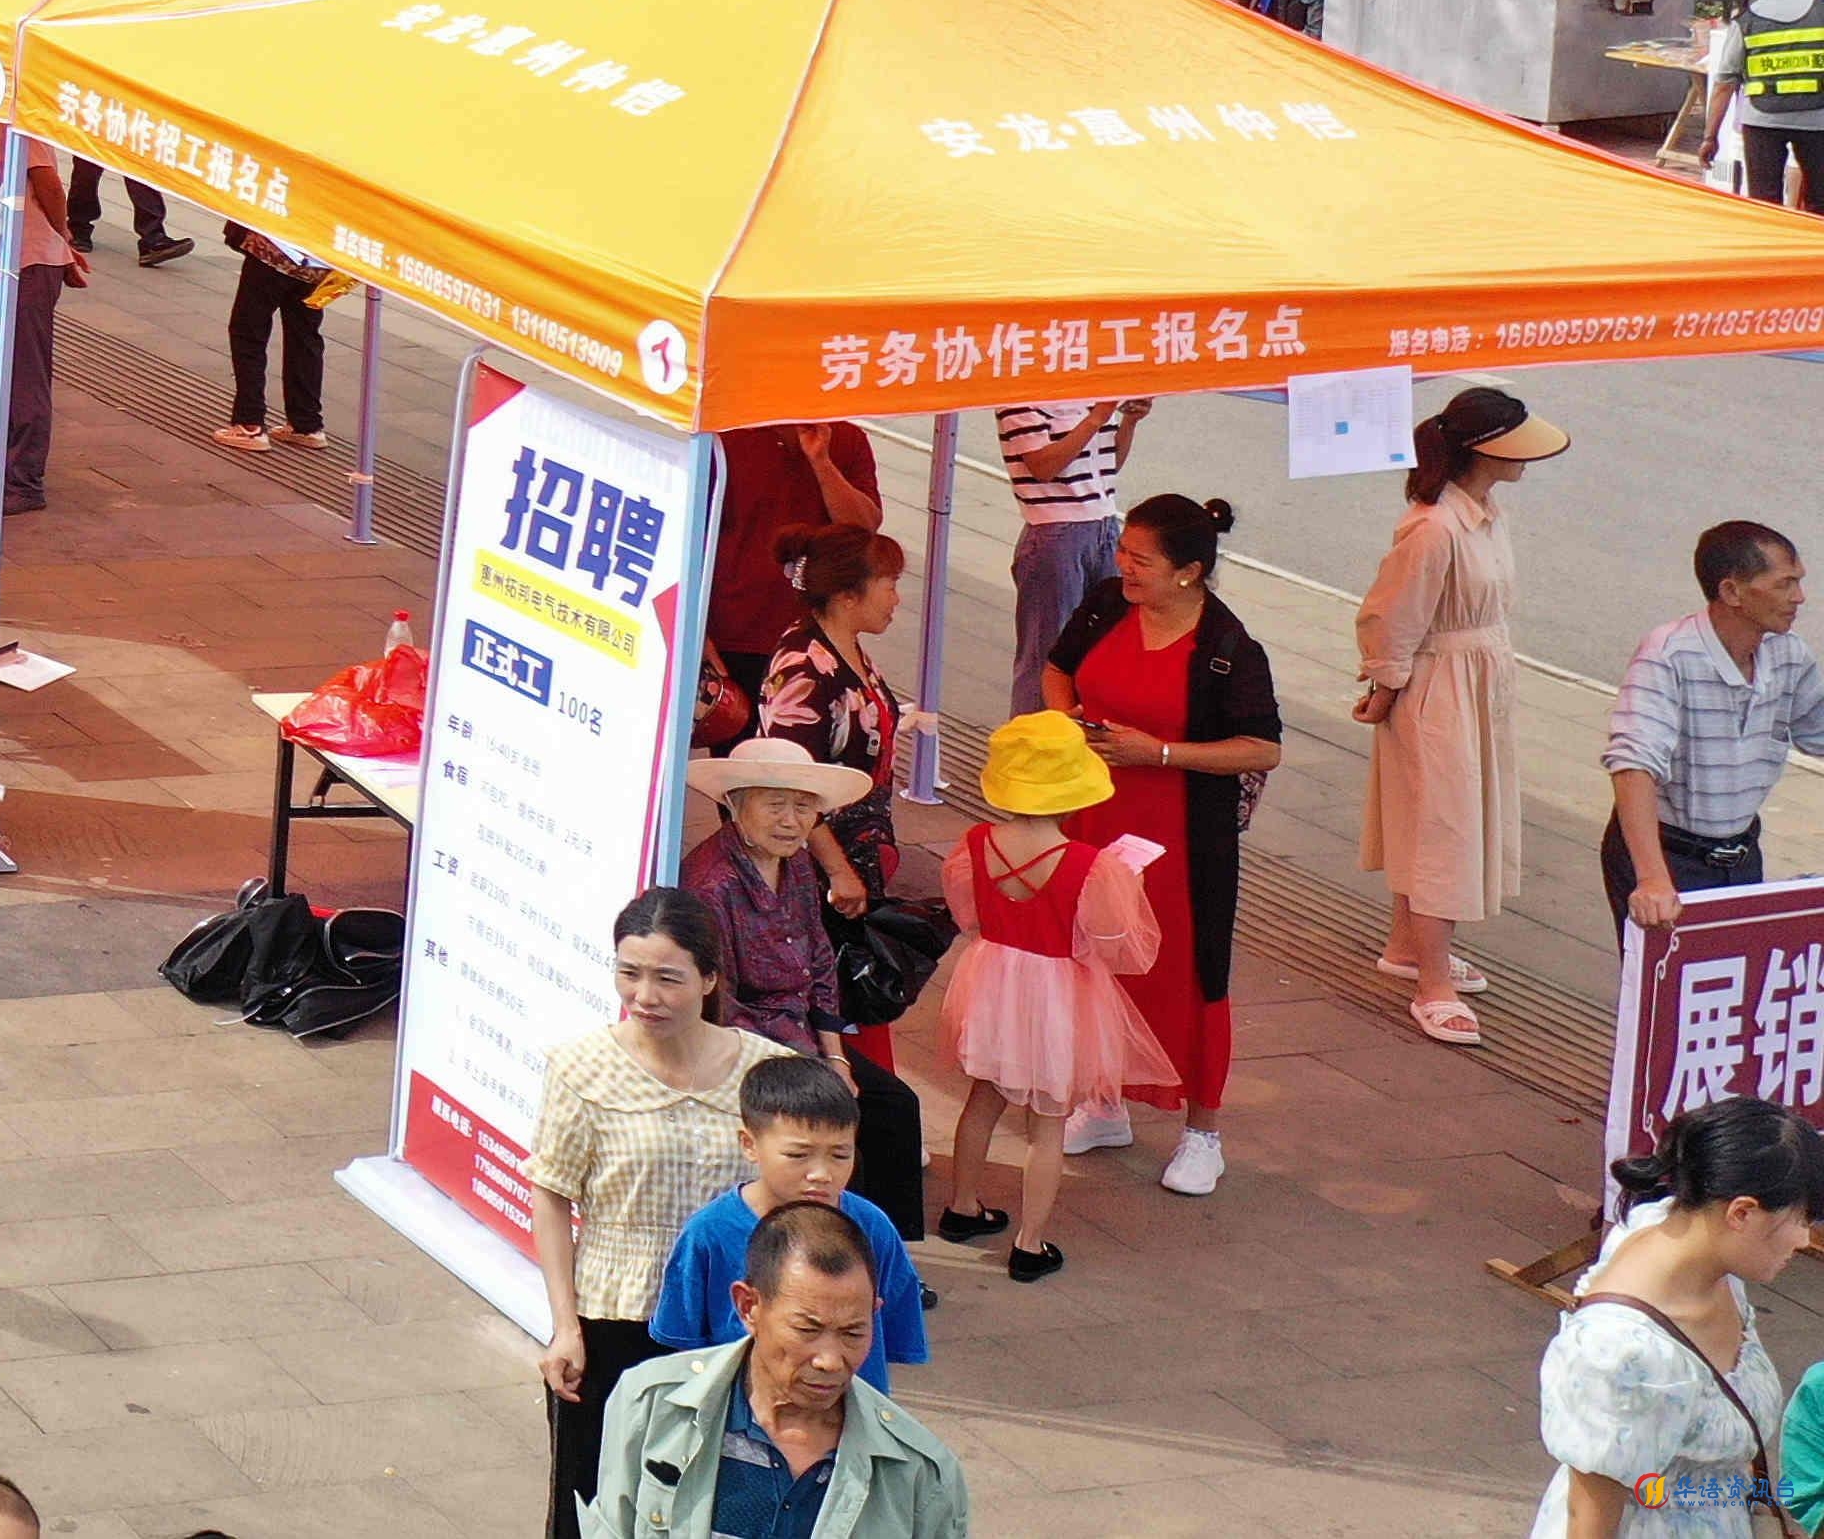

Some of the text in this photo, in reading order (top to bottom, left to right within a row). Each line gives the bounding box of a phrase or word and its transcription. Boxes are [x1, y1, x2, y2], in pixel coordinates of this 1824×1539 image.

[56, 81, 290, 216] 劳务协作招工报名点
[396, 254, 502, 323] 16608597631
[511, 308, 624, 378] 13118513909
[820, 305, 1308, 390] 劳务协作招工报名点
[1494, 315, 1658, 350] 16608597631
[1670, 307, 1823, 341] 13118513909
[500, 445, 666, 608] 招聘
[479, 563, 636, 657] 惠州拓邦电气技术有限公司
[470, 628, 545, 699] 正式工
[557, 691, 603, 736] 100名
[1661, 941, 1824, 1123] 展销
